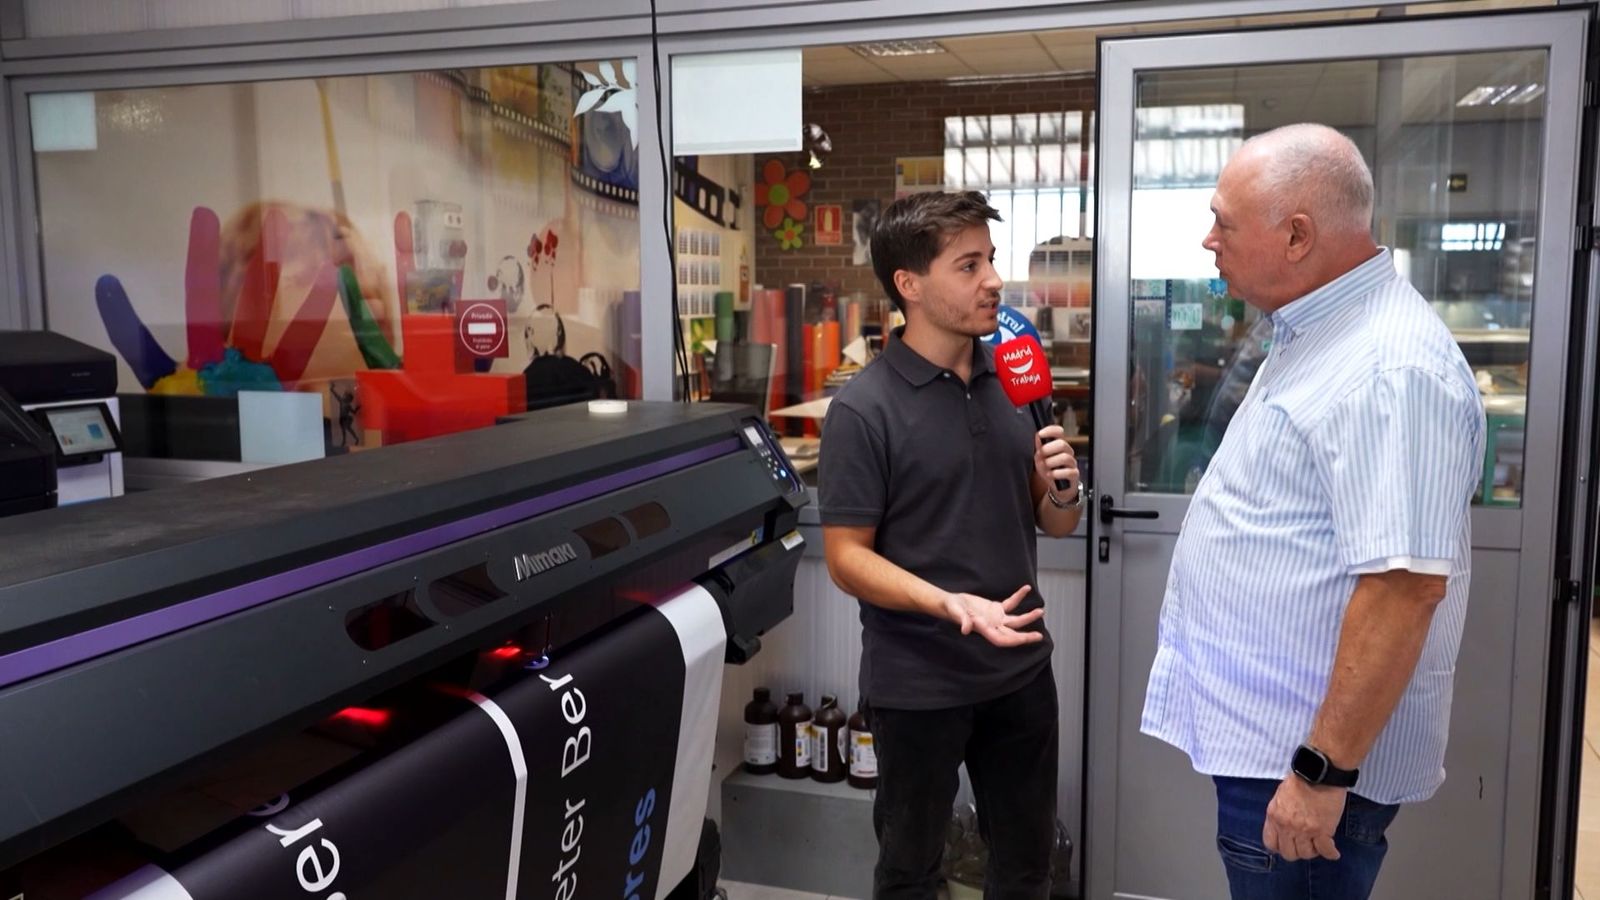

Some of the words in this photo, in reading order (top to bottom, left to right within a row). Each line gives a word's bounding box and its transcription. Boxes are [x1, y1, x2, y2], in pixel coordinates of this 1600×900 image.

[1003, 345, 1033, 362] Madrid
[1010, 373, 1041, 387] Trabaja
[622, 788, 656, 900] res
